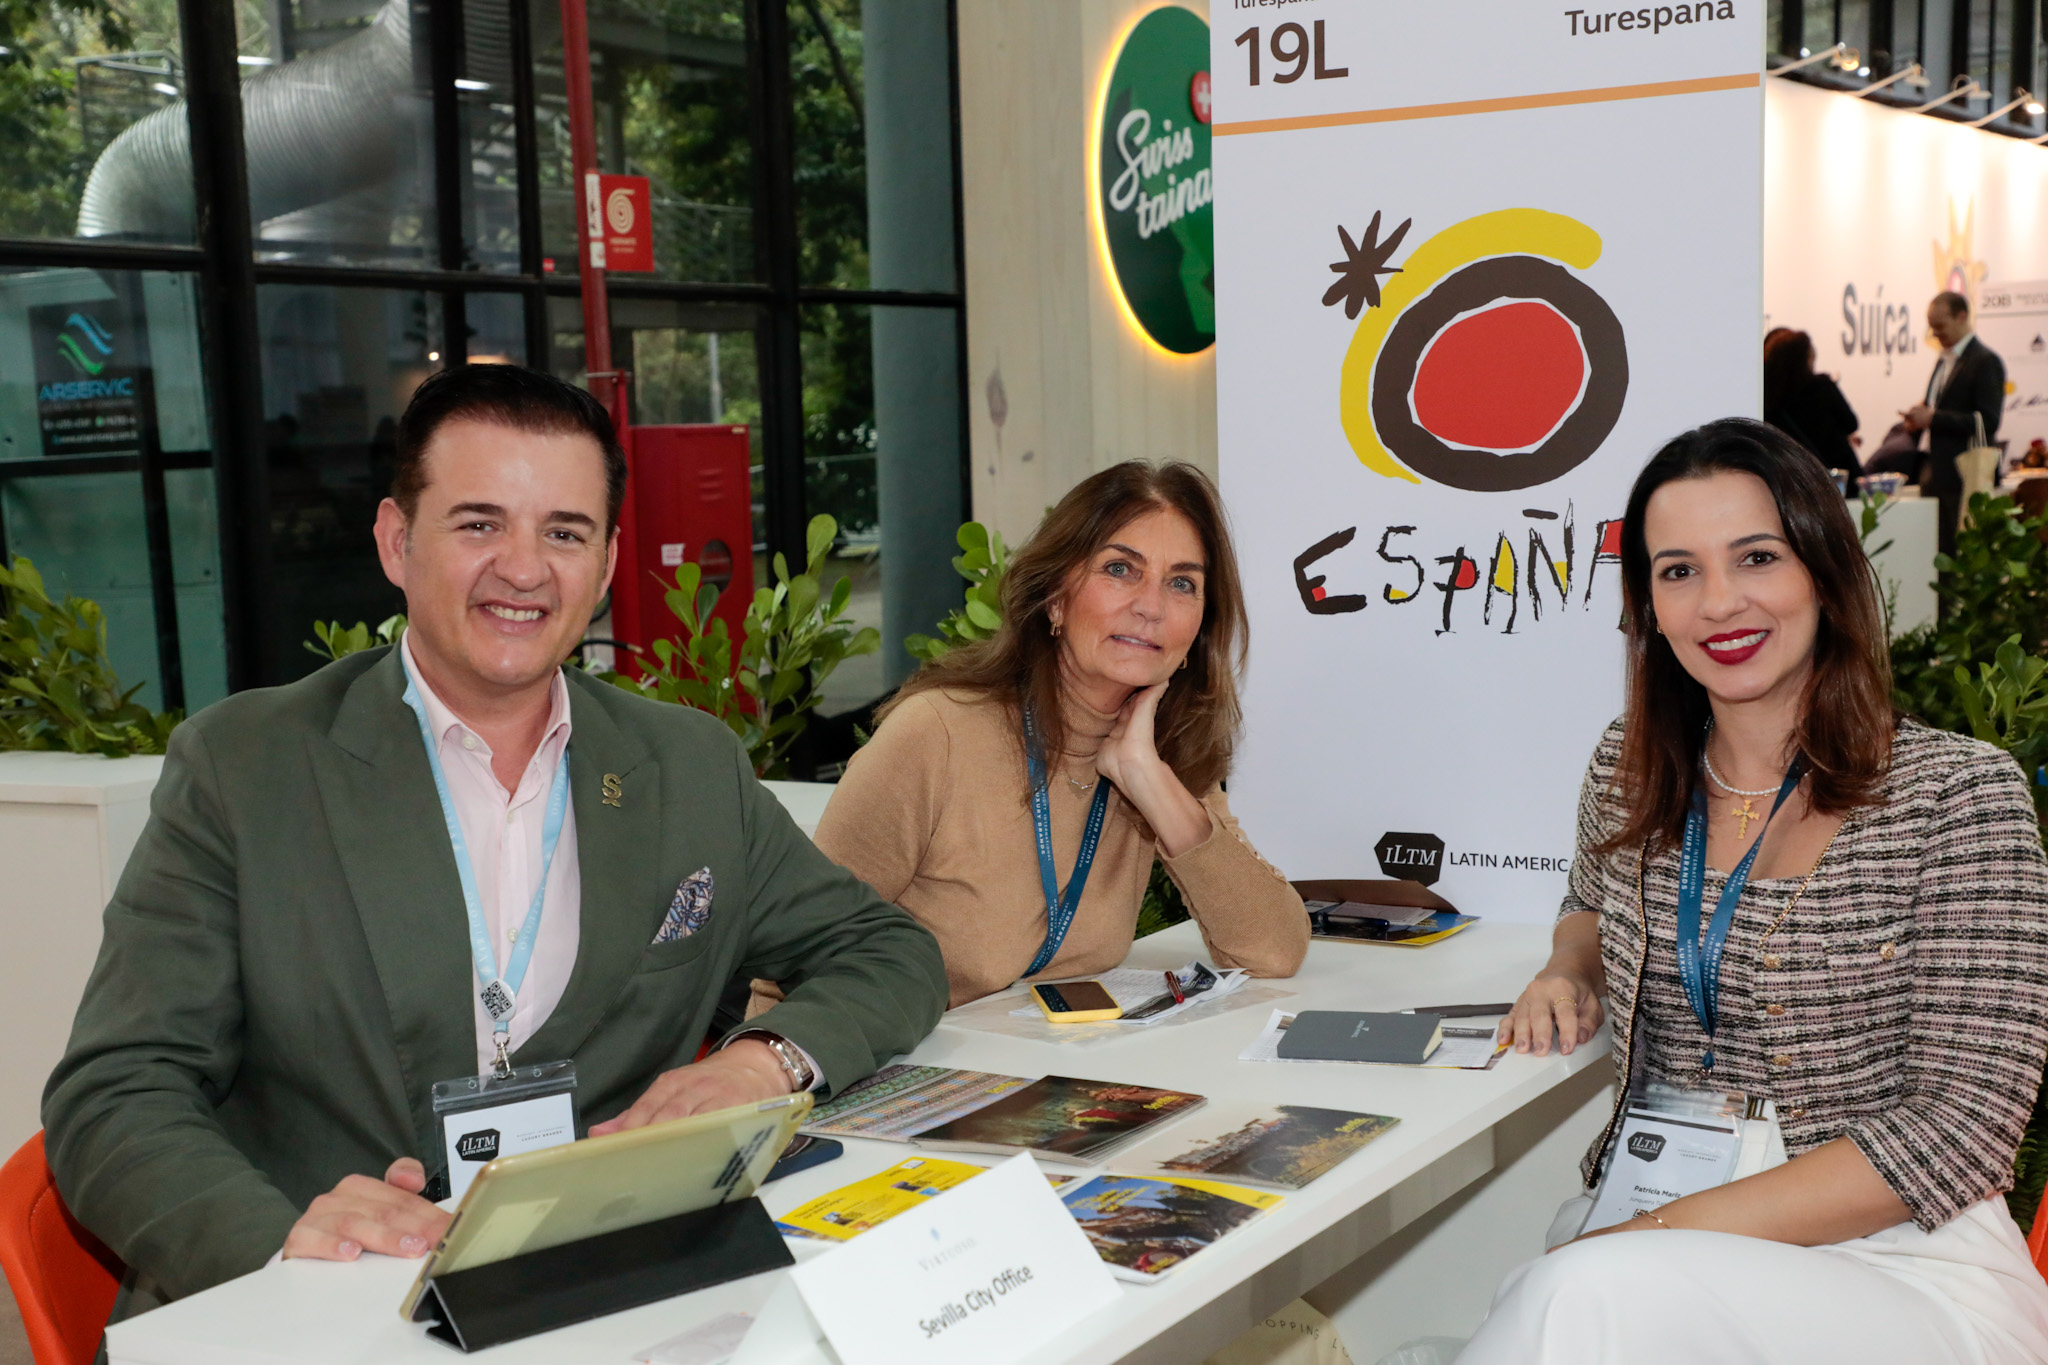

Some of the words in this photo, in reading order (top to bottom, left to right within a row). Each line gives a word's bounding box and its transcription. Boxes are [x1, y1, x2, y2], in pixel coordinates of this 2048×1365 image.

[1234, 19, 1349, 86] 19L
[1109, 108, 1194, 212] Swiss
[1841, 282, 1918, 377] Suíça.
[1037, 822, 1046, 855] BRANDS
[1085, 834, 1097, 864] LUXURY
[1093, 802, 1105, 833] BRANDS
[1686, 819, 1695, 852] LUXURY
[1384, 844, 1437, 867] ILTM
[1450, 852, 1498, 868] LATIN
[1502, 855, 1569, 873] AMERIC
[1681, 854, 1691, 890] BRANDS
[1689, 848, 1699, 898] INTERNATIONAL
[1056, 910, 1073, 941] BRANDS
[1679, 947, 1688, 984] LUXURY
[1703, 933, 1716, 988] INTERNATIONAL
[1710, 942, 1721, 980] BRANDS
[462, 1135, 496, 1151] ILTM
[462, 1149, 476, 1157] LATIN
[475, 1145, 496, 1154] AMERICA
[1632, 1136, 1662, 1150] ILTM
[1634, 1185, 1661, 1196] Patricia
[1661, 1189, 1681, 1198] Mariz
[919, 1302, 968, 1339] Sevilla
[965, 1286, 996, 1311] City
[992, 1265, 1033, 1296] Office
[1257, 1318, 1319, 1340] OPPING
